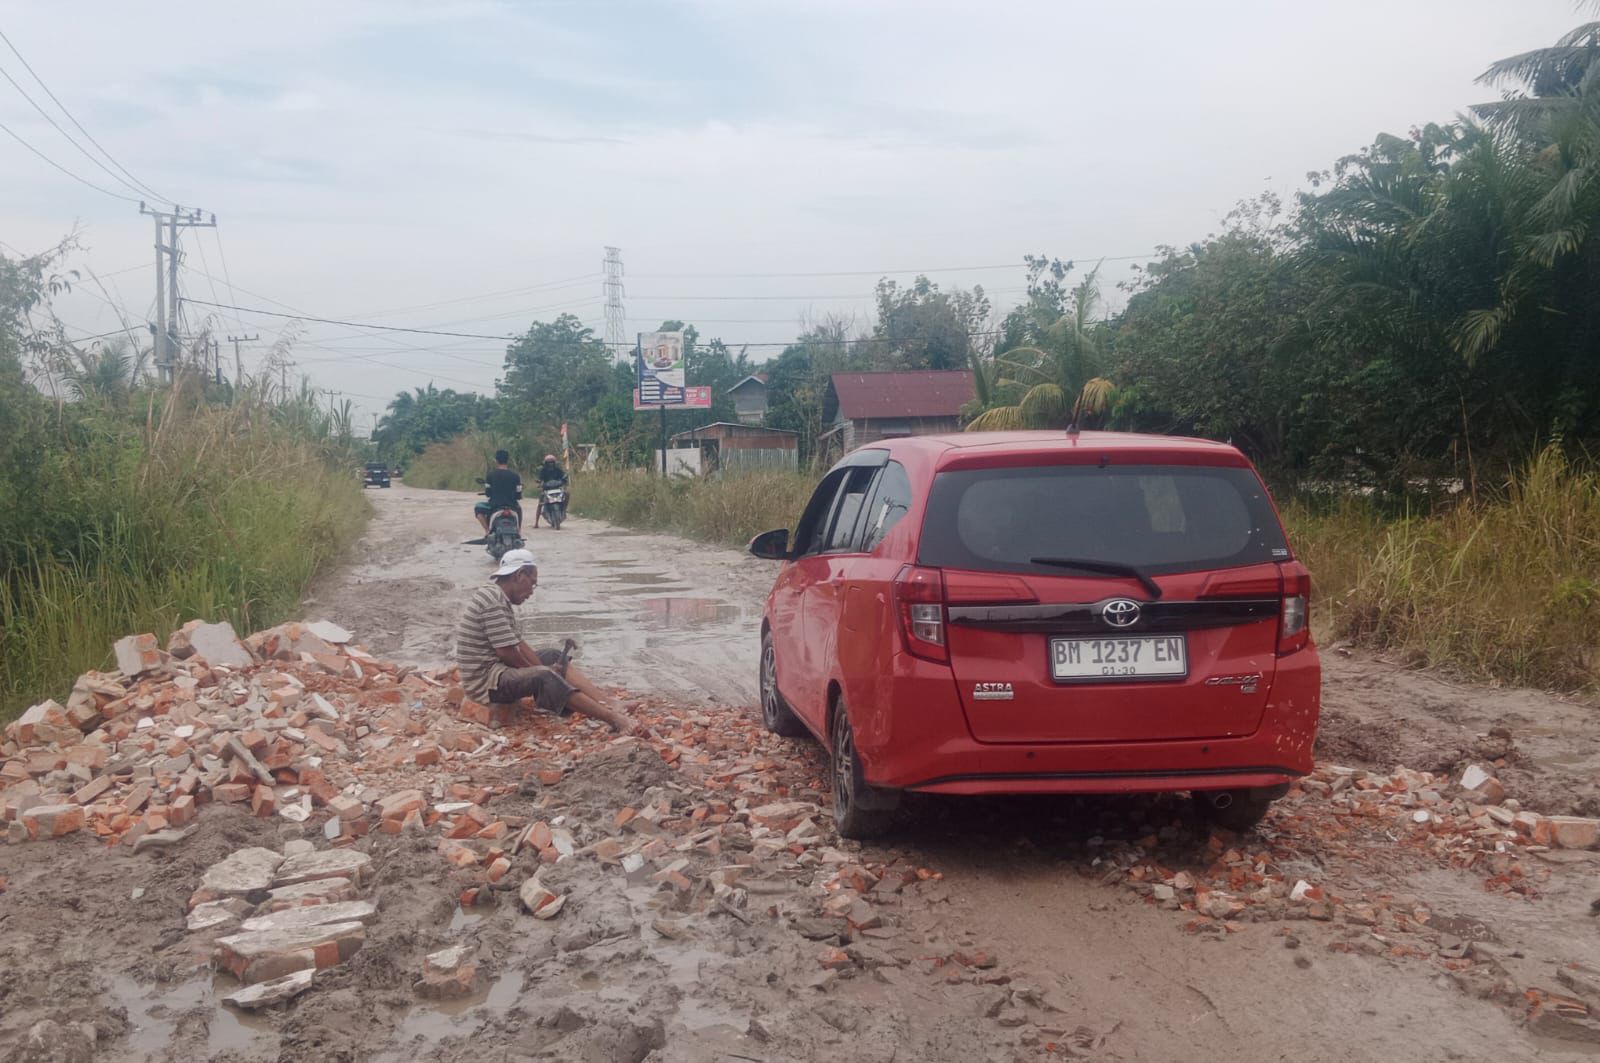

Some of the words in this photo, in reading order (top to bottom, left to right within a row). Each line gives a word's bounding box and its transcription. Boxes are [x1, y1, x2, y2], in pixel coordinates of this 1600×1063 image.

[1055, 641, 1081, 665] BM
[1091, 640, 1142, 664] 1237
[1154, 638, 1180, 662] EN
[974, 682, 1013, 692] ASTRA
